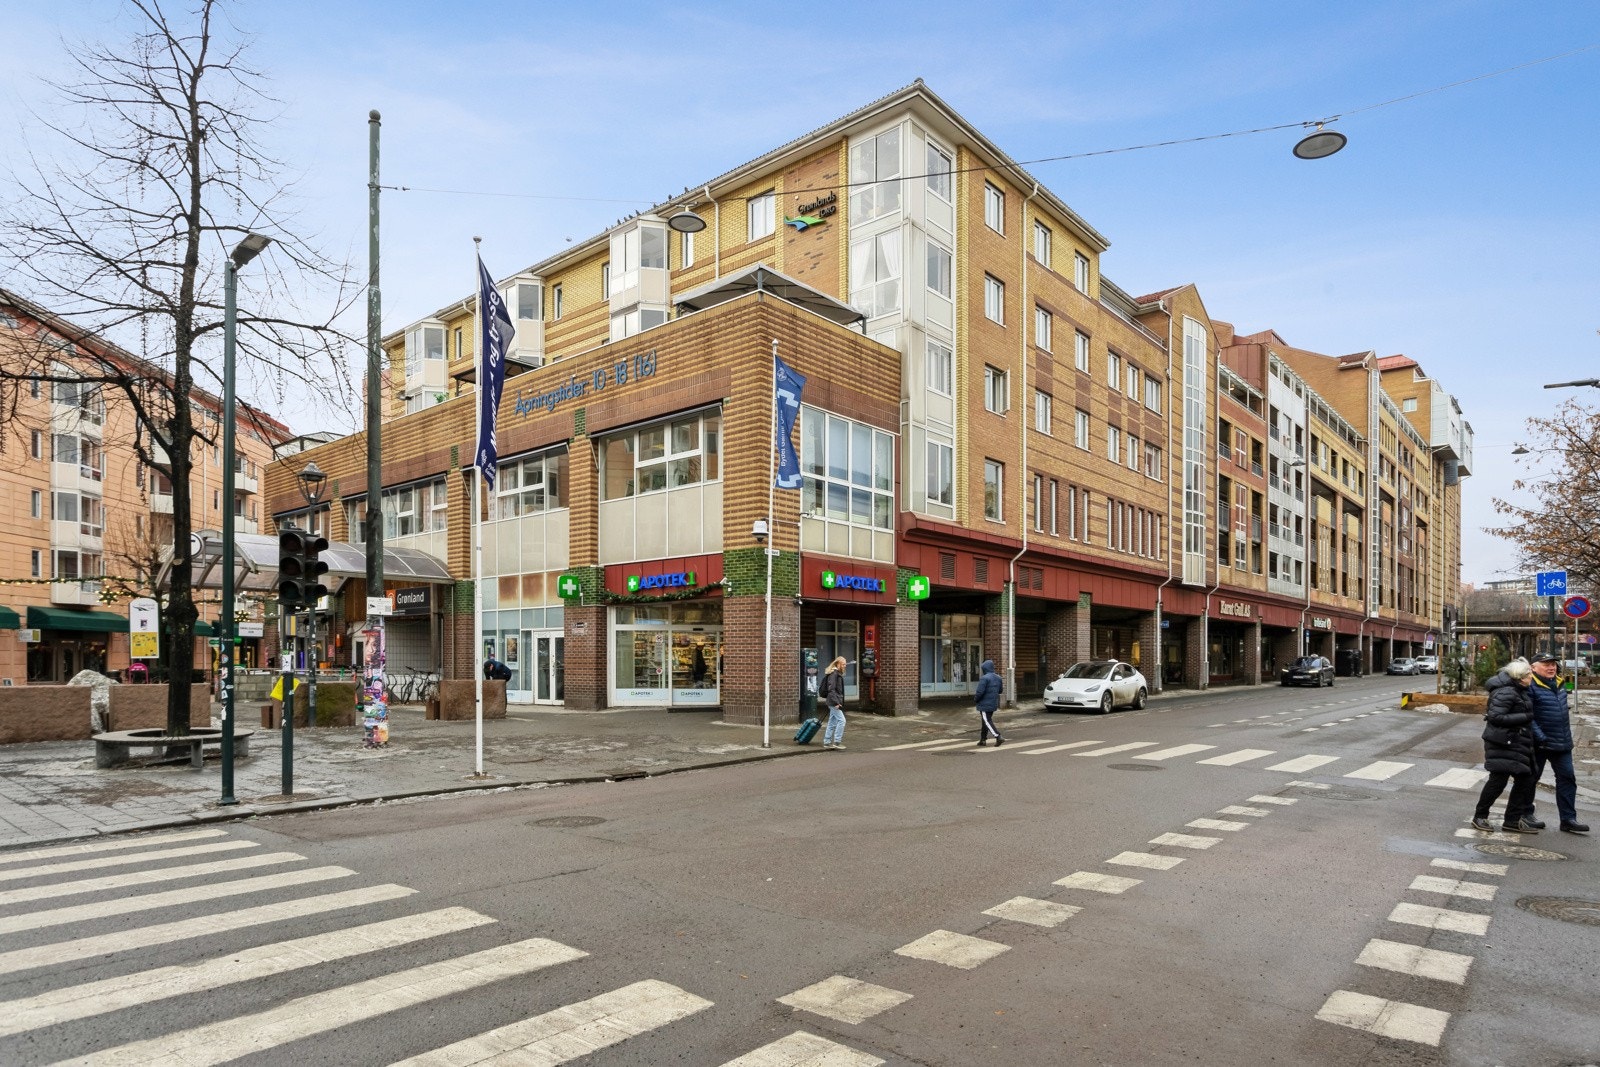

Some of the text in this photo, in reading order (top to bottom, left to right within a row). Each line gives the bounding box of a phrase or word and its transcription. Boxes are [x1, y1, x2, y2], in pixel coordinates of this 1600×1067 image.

[489, 343, 500, 368] og
[592, 368, 607, 391] 10
[614, 361, 628, 385] 18
[633, 349, 657, 381] (16)
[638, 571, 697, 589] APOTEK 1
[835, 574, 887, 592] APOTEK 1
[396, 591, 425, 604] Grønland
